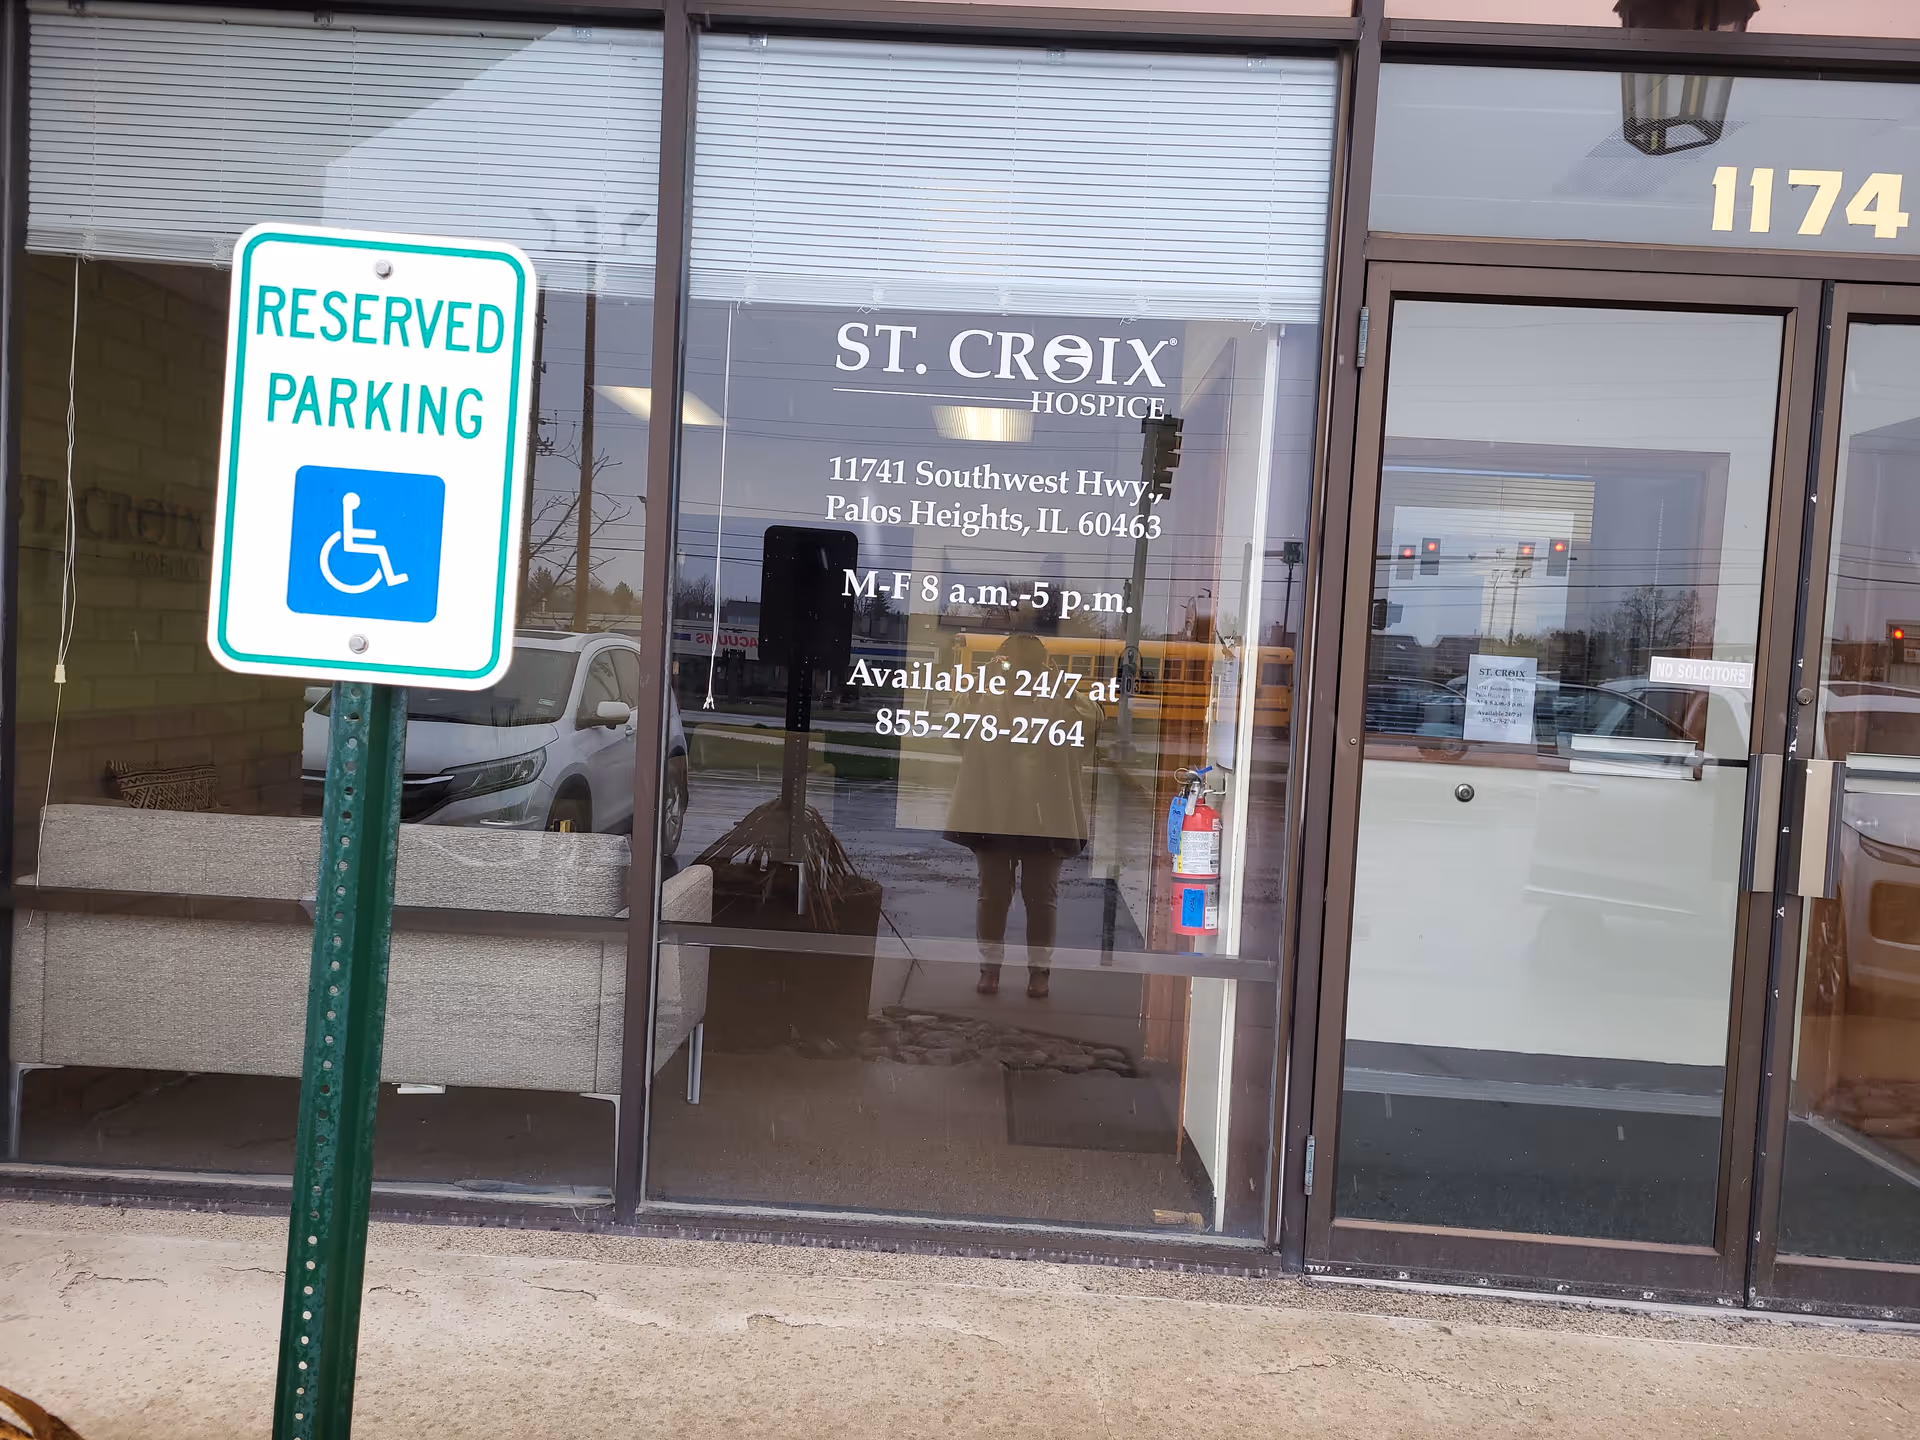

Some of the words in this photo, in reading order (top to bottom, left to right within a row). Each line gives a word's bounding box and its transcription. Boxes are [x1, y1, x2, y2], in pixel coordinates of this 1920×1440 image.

[1711, 166, 1910, 239] 1174
[256, 284, 506, 354] RESERVED
[835, 322, 928, 375] ST.
[267, 372, 484, 440] PARKING
[1030, 391, 1166, 420] HOSPICE
[829, 456, 907, 485] 11741
[915, 461, 1069, 494] Southwest
[1076, 469, 1163, 506] Hwy.,
[824, 495, 902, 525] Palos
[909, 500, 1030, 538] Heights,
[1036, 508, 1069, 534] IL
[1078, 511, 1162, 540] 60463
[841, 569, 911, 600] M-F
[921, 575, 939, 602] 8
[949, 581, 1050, 609] a.m.-5
[1059, 590, 1133, 619] p.m.
[846, 658, 1006, 695] Available
[1013, 669, 1082, 700] 24/7
[1088, 675, 1120, 703] at
[1479, 668, 1493, 676] ST.
[1495, 669, 1526, 678] CROIX
[1656, 662, 1674, 678] NO
[1677, 663, 1746, 684] SOLICITORS
[875, 707, 1085, 747] 855-278-2764
